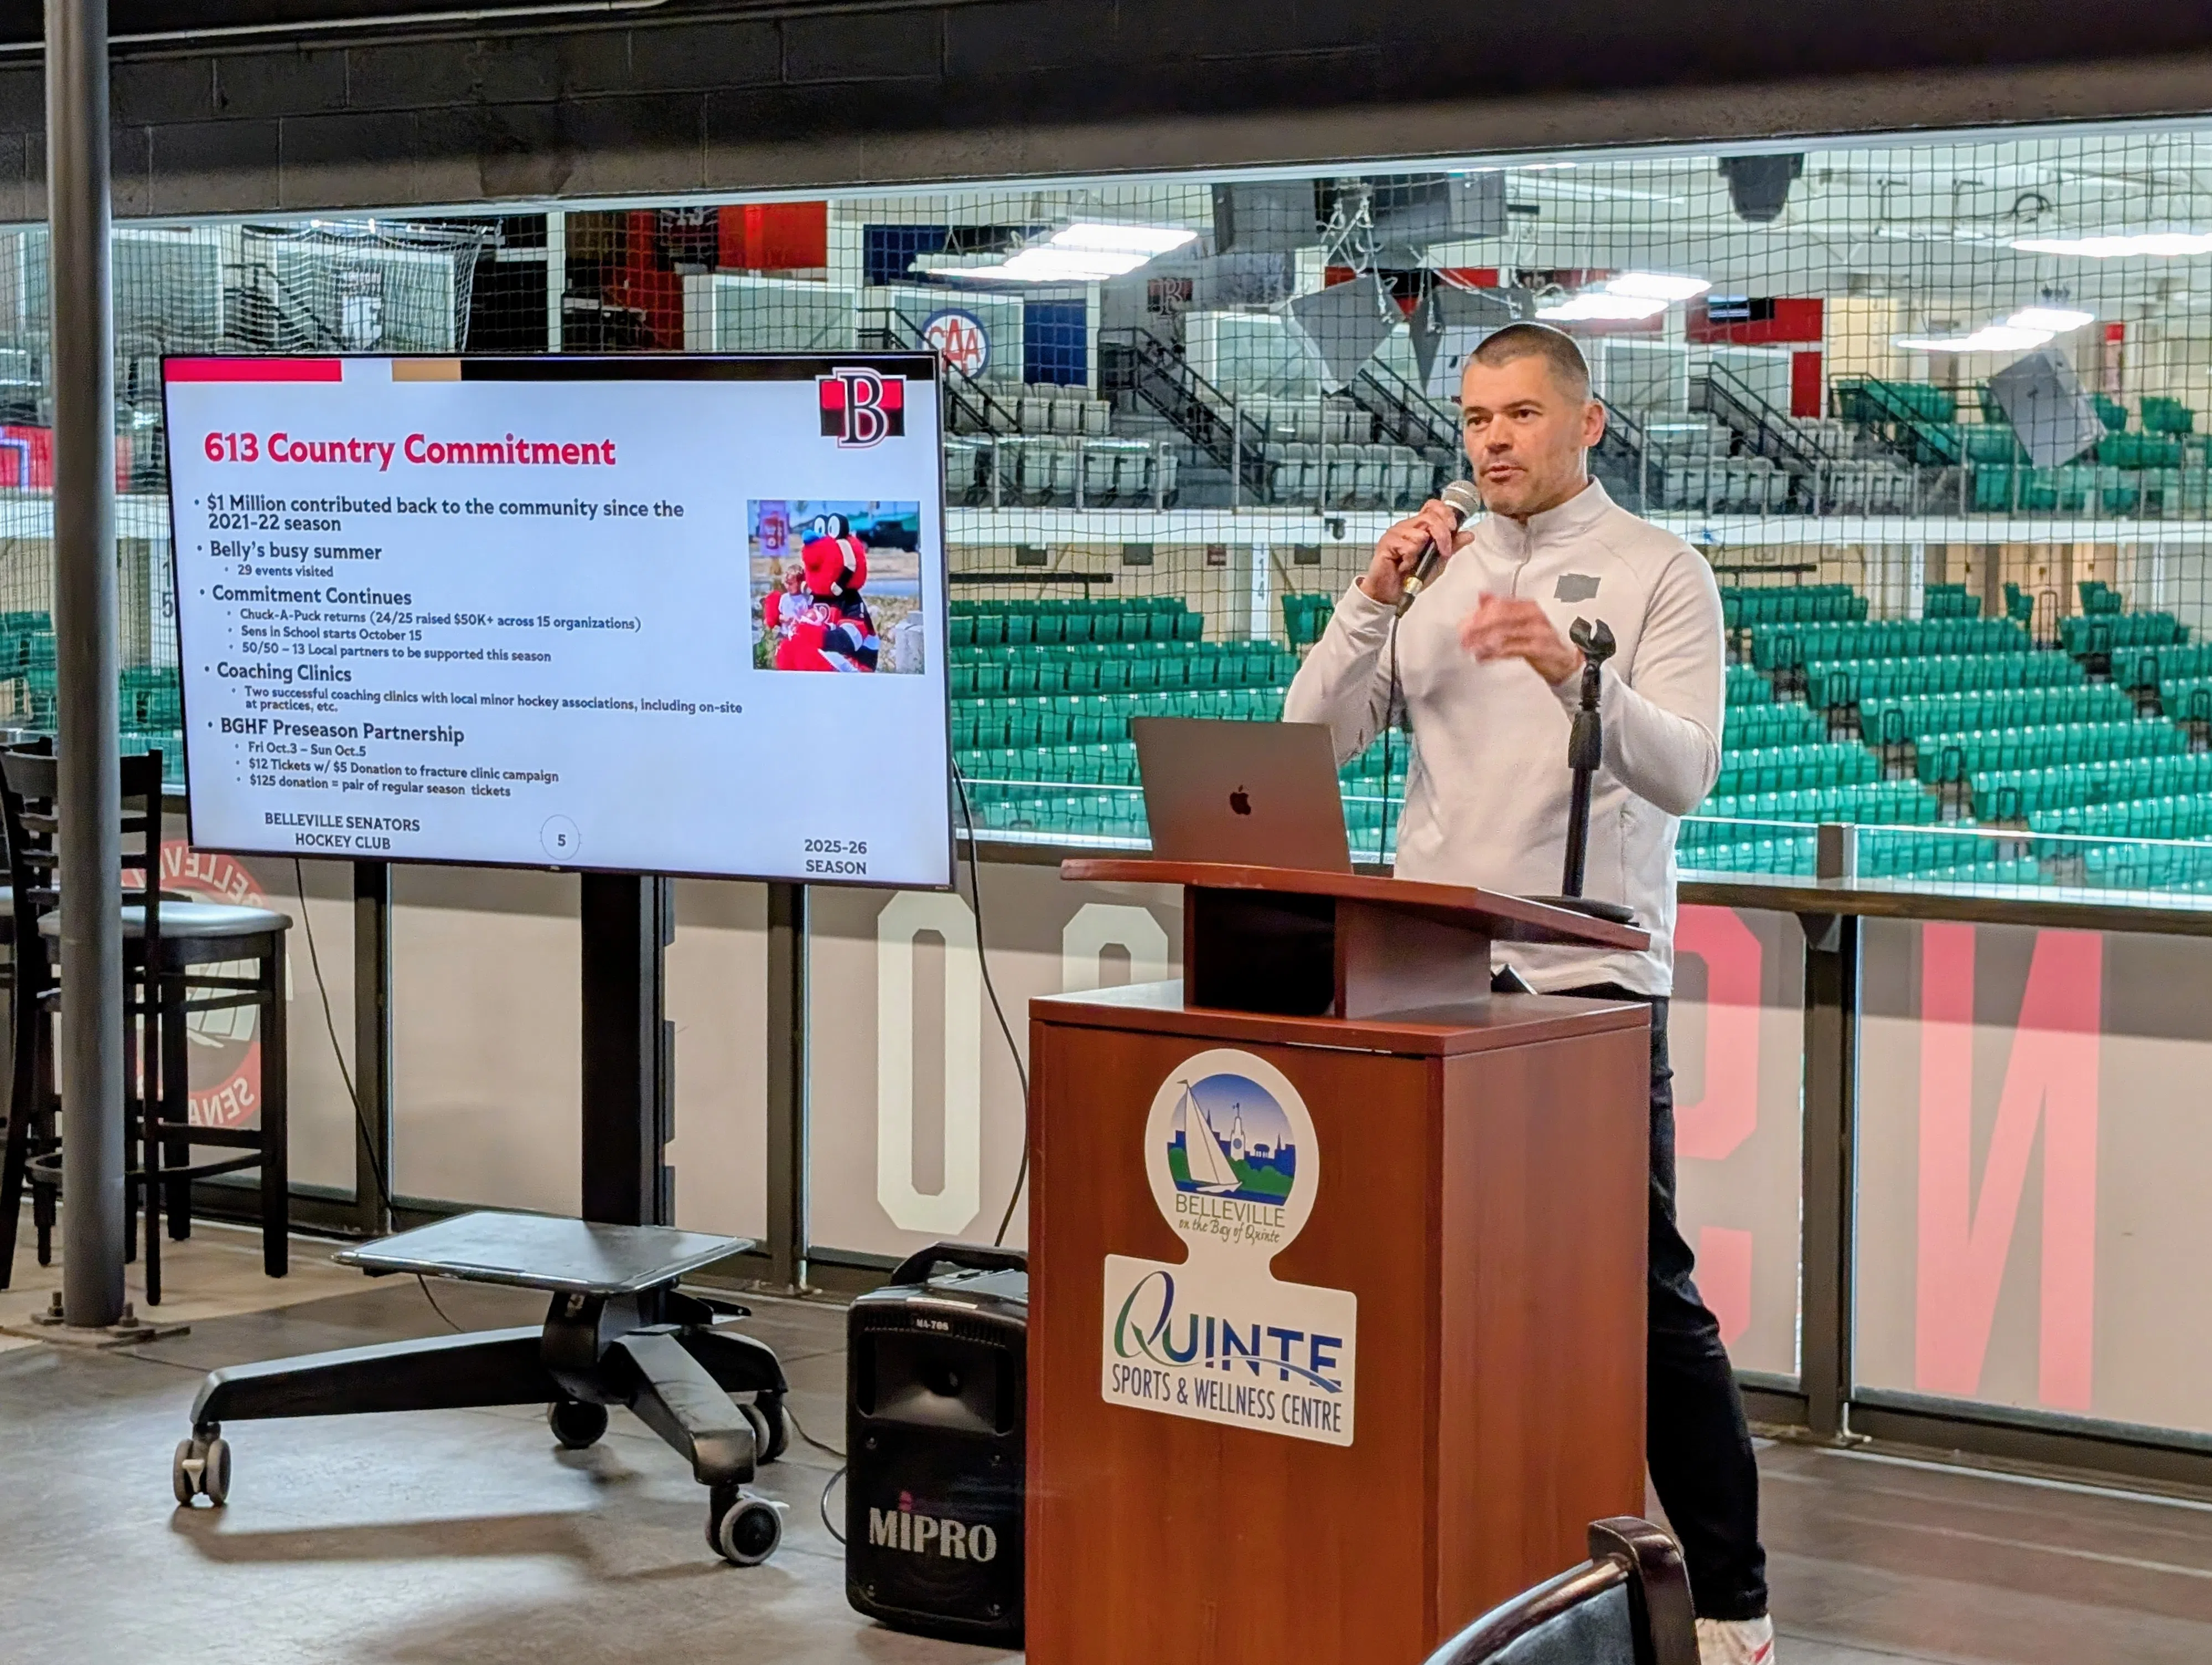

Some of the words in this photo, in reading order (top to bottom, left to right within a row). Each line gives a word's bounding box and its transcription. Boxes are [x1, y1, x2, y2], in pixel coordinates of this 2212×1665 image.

[928, 318, 982, 375] CAA
[832, 367, 889, 449] B
[204, 432, 259, 463] 613
[267, 432, 396, 472] Country
[404, 433, 616, 465] Commitment
[207, 492, 224, 512] $1
[229, 494, 287, 512] Million
[291, 495, 392, 513] contributed
[396, 496, 438, 514] back
[441, 500, 460, 515] to
[465, 497, 494, 515] the
[499, 497, 599, 520] community
[603, 498, 649, 517] since
[653, 499, 684, 517] the
[208, 512, 280, 531] 2021-22
[284, 518, 341, 532] season
[269, 541, 309, 563] busy
[314, 546, 382, 561] summer
[237, 563, 252, 576] 29
[255, 566, 293, 577] events
[295, 564, 334, 578] visited
[212, 584, 322, 603] Commitment
[325, 587, 412, 606] Continues
[240, 608, 322, 622] Chuck-A-Puck
[324, 612, 366, 624] returns
[370, 610, 413, 626] (24/25
[416, 612, 451, 625] raised
[454, 613, 494, 626] $50K+
[498, 617, 535, 627] across
[537, 615, 551, 627] 15
[553, 615, 641, 633] organizations)
[241, 624, 267, 637] Sens
[270, 625, 281, 637] in
[283, 625, 320, 639] School
[323, 629, 357, 640] starts
[359, 627, 406, 641] October
[408, 629, 422, 641] 15
[242, 640, 279, 655] 50/50
[292, 642, 305, 655] 13
[308, 643, 338, 656] Local
[340, 646, 390, 660] partners
[391, 647, 405, 658] to
[407, 646, 422, 659] be
[424, 647, 484, 662] supported
[486, 648, 509, 661] this
[511, 652, 552, 662] season
[217, 661, 293, 685] Coaching
[297, 663, 352, 682] Clinics
[244, 684, 270, 698] Two
[272, 687, 329, 699] successful
[330, 688, 381, 704] coaching
[383, 689, 418, 703] clinics
[421, 691, 448, 704] with
[450, 692, 478, 706] local
[480, 693, 515, 707] minor
[517, 693, 560, 711] hockey
[562, 696, 638, 713] associations,
[640, 697, 696, 715] including
[698, 701, 743, 714] on-site
[245, 698, 257, 709] at
[260, 698, 314, 714] practices,
[317, 702, 338, 713] etc.
[221, 717, 268, 735] BGHF
[273, 718, 359, 739] Preseason
[363, 722, 464, 747] Partnership
[248, 740, 264, 753] Fri
[310, 743, 333, 756] Sun
[248, 756, 268, 770] $12
[270, 758, 312, 772] Tickets
[313, 759, 331, 774] w/
[333, 760, 348, 774] $5
[350, 761, 402, 776] Donation
[404, 766, 418, 776] to
[419, 764, 468, 779] fracture
[470, 766, 500, 780] clinic
[502, 769, 559, 785] campaign
[250, 772, 276, 787] $125
[278, 775, 329, 789] donation
[342, 777, 365, 793] pair
[367, 779, 379, 792] of
[382, 780, 424, 796] regular
[426, 785, 465, 796] season
[471, 783, 511, 797] tickets
[265, 812, 344, 829] BELLEVILLE
[346, 815, 420, 832] SENATORS
[295, 832, 351, 848] HOCKEY
[355, 836, 391, 850] CLUB
[557, 833, 566, 847] 5
[804, 838, 867, 855] 2025-26
[806, 859, 867, 875] SEASON
[1175, 1193, 1286, 1228] BELLEVILLE
[1178, 1218, 1190, 1229] on
[1192, 1214, 1208, 1232] the
[1210, 1217, 1231, 1243] Bay
[1233, 1221, 1245, 1244] of
[1245, 1224, 1281, 1245] Quinte
[1114, 1271, 1343, 1393] QUINTE
[1112, 1363, 1171, 1402] SPORTS
[1177, 1377, 1189, 1405] &
[1194, 1377, 1276, 1421] WELLNESS
[1281, 1393, 1342, 1433] CENTRE
[869, 1506, 997, 1563] MIPRO
